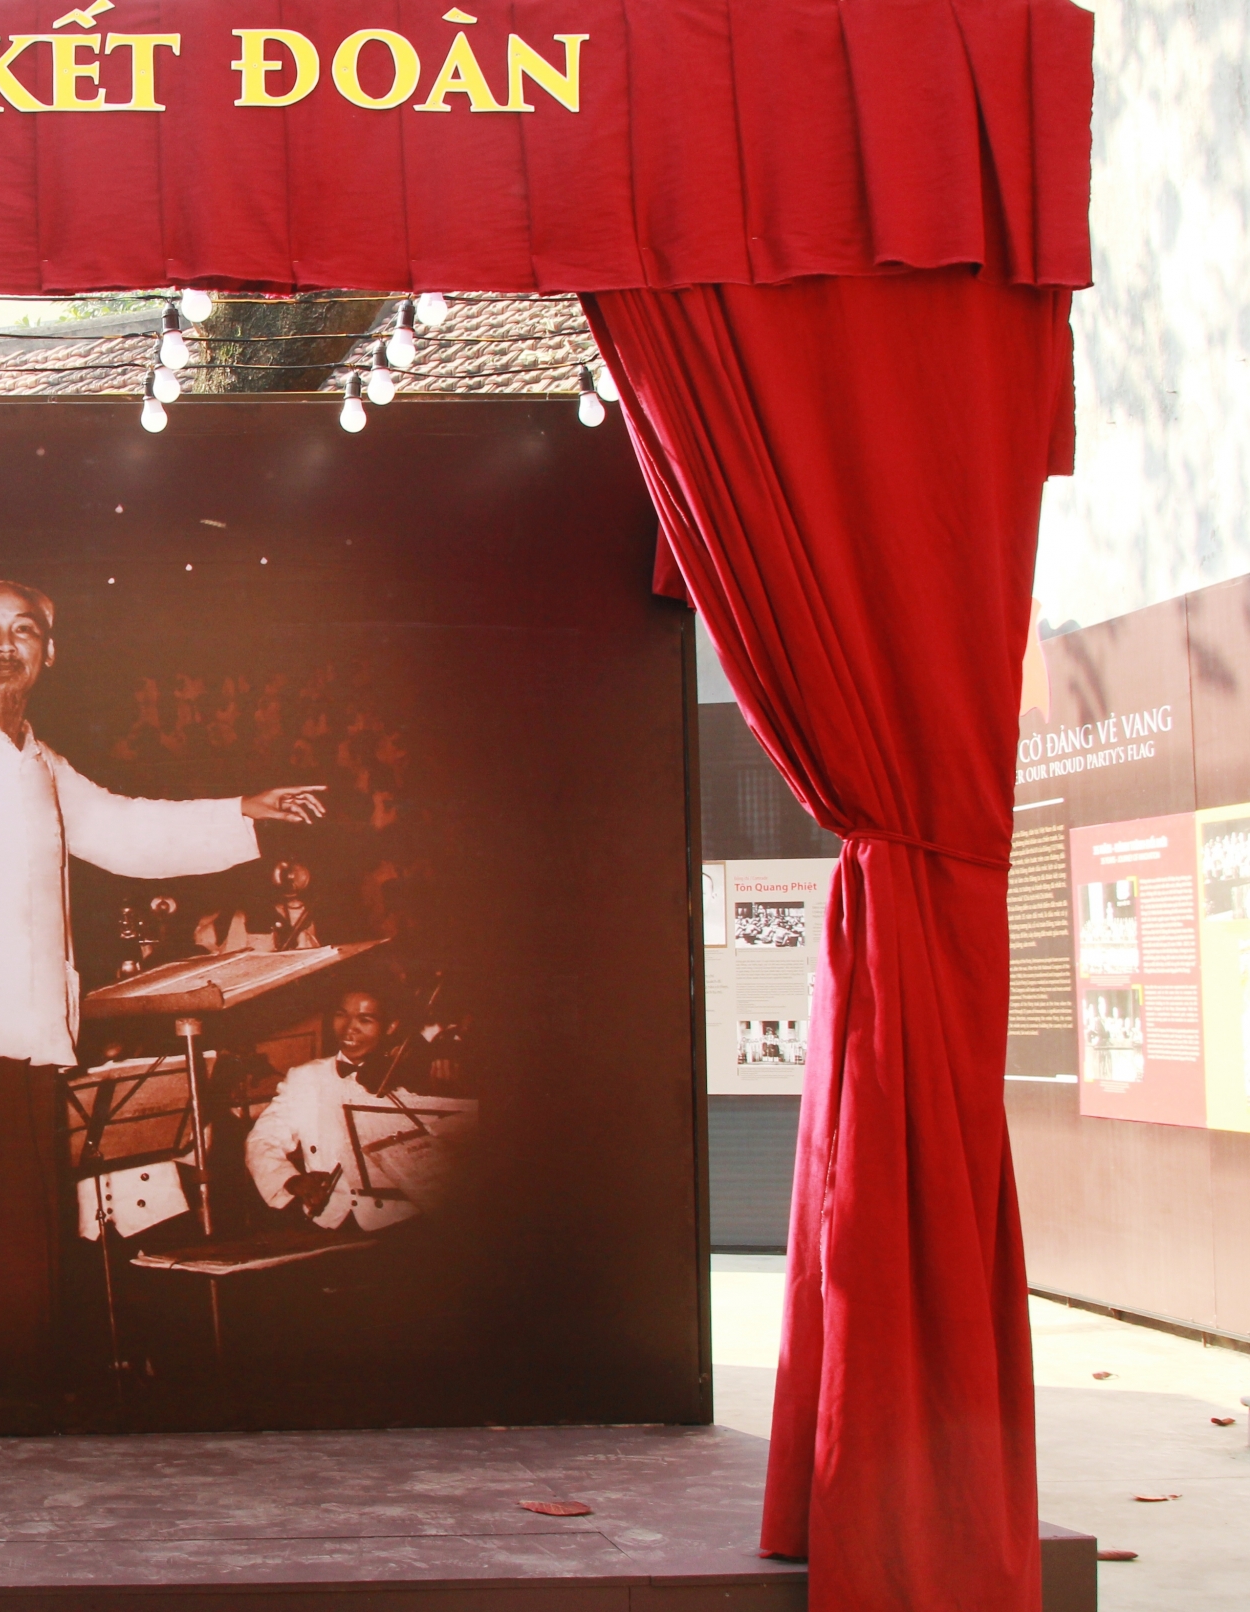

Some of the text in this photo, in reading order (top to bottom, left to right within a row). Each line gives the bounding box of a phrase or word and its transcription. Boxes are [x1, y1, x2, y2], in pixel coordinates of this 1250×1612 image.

[231, 8, 589, 113] ĐOÀN
[1019, 705, 1172, 763] CỜ ĐẢNG VẺ VANG
[1026, 764, 1048, 782] OUR
[1049, 756, 1084, 778] PROUD
[1087, 746, 1125, 769] PARTY'S
[1127, 740, 1155, 761] FLAG
[734, 883, 752, 891] Tôn
[755, 883, 788, 893] Quang
